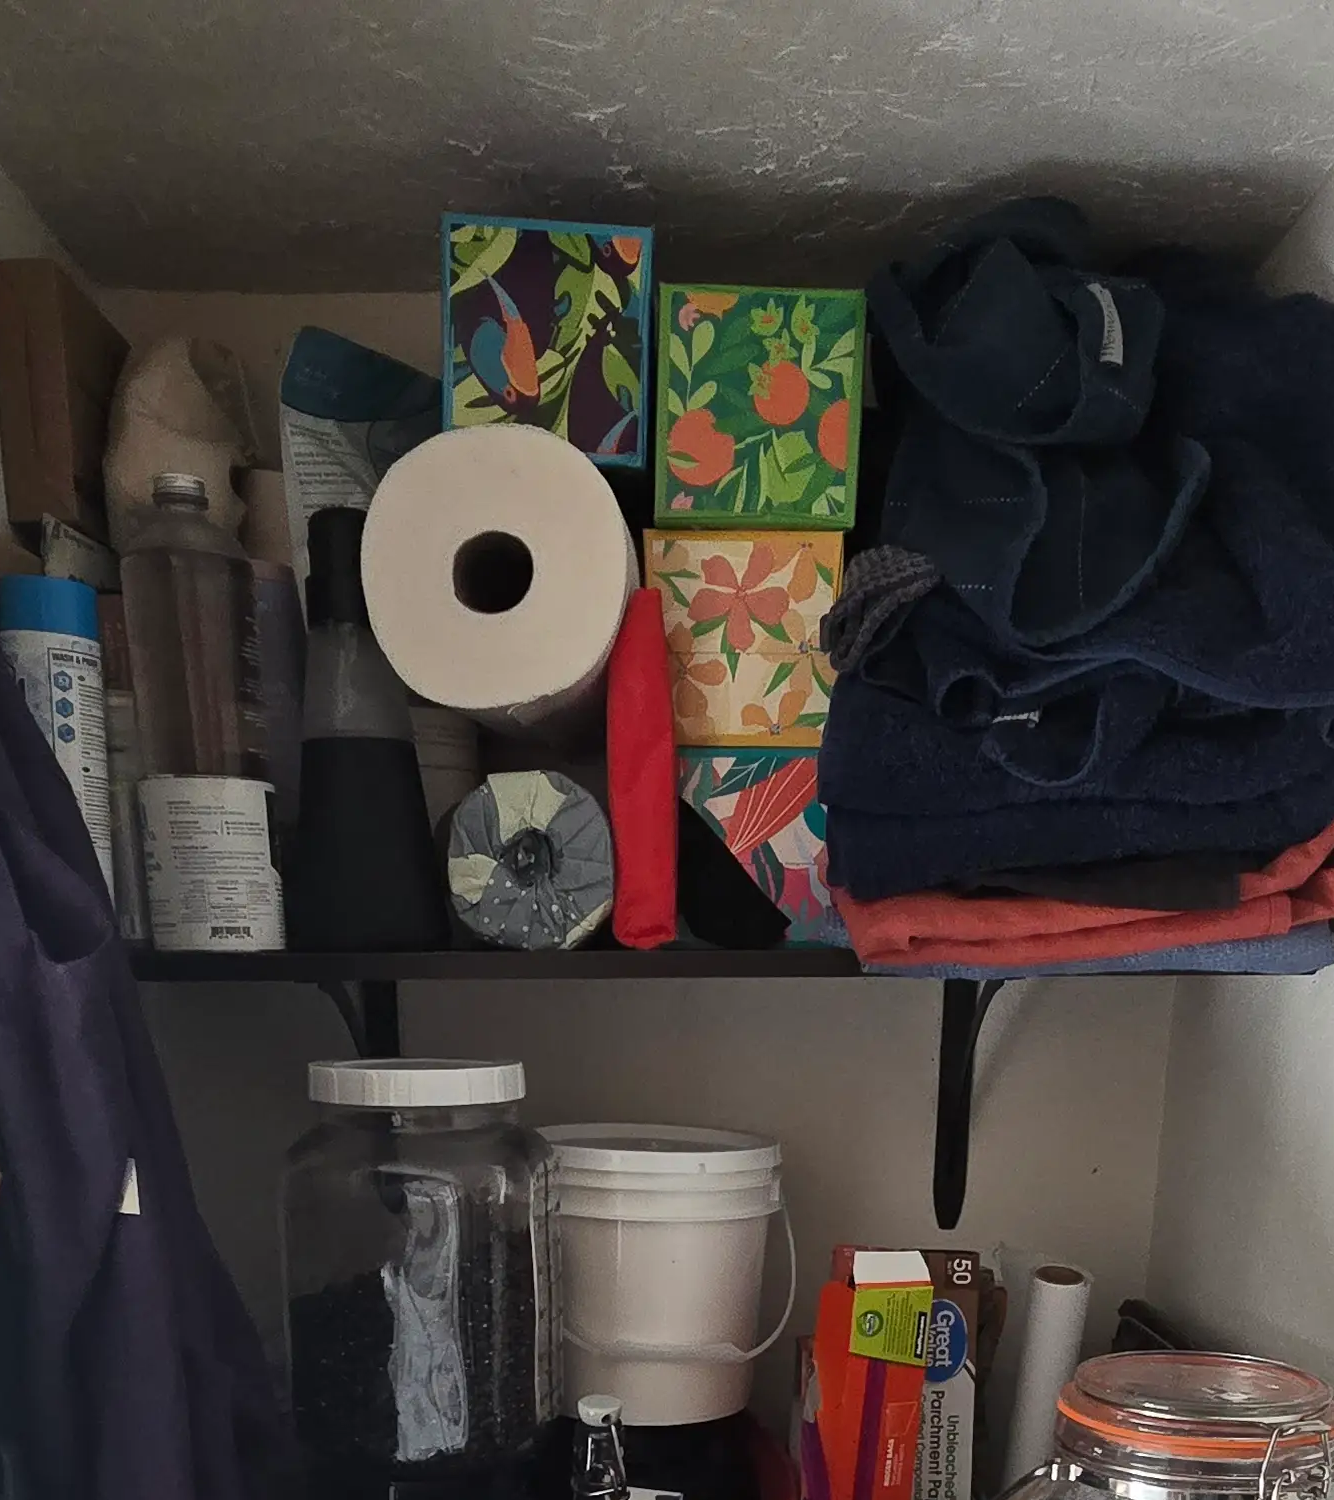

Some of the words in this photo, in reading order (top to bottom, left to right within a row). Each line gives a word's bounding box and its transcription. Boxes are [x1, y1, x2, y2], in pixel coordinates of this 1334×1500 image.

[952, 1258, 972, 1285] 50
[935, 1310, 956, 1367] Great
[927, 1390, 945, 1475] Parchment
